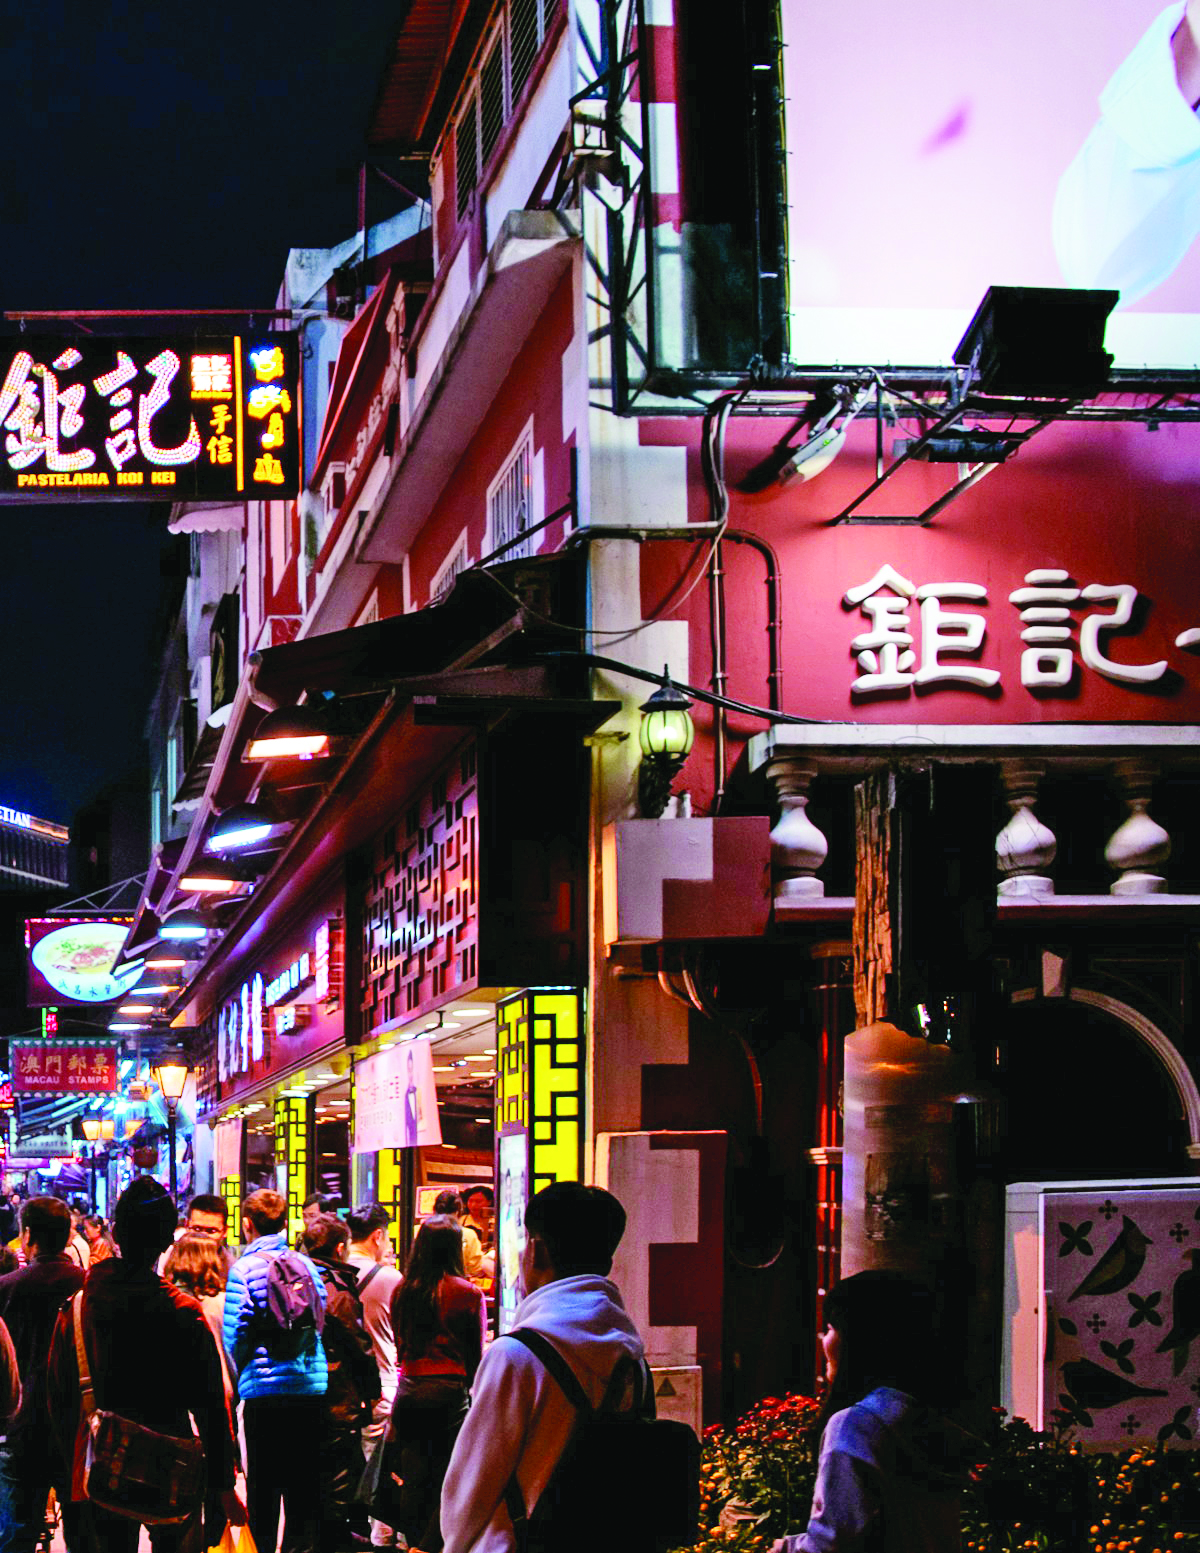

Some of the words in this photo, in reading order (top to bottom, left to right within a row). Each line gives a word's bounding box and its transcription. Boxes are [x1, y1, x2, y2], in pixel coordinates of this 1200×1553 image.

[207, 404, 233, 464] 手信
[17, 471, 110, 487] PASTELARIA
[116, 471, 143, 486] KOI
[151, 471, 176, 485] KEI
[843, 563, 1200, 694] 鉅記
[20, 1053, 110, 1075] 澳門郵票
[24, 1075, 60, 1084] MACAU
[68, 1075, 109, 1084] STAMPS
